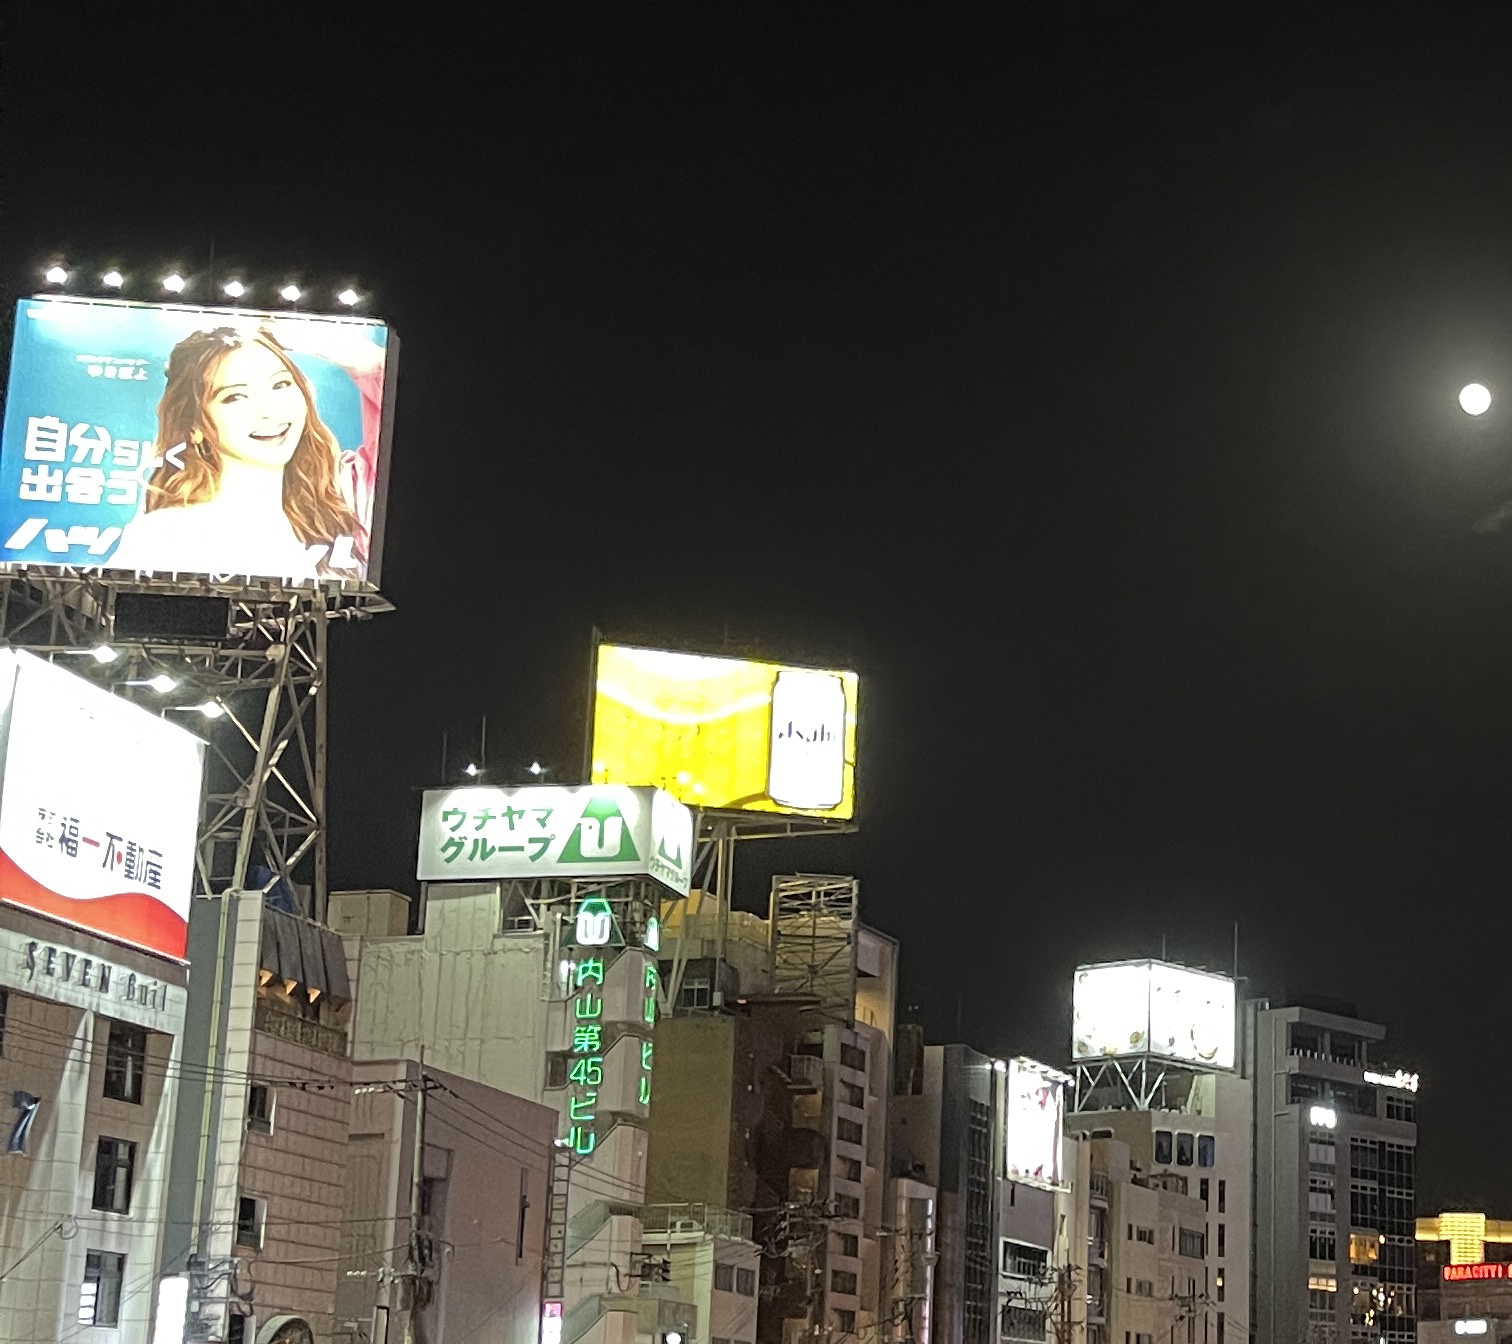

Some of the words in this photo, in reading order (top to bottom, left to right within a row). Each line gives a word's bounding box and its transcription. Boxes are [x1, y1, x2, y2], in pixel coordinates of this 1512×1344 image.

[442, 805, 554, 833] ウチヤマ
[439, 834, 556, 864] グループ
[25, 941, 113, 994] SEVEN
[569, 957, 604, 1155] 内山第45ビル
